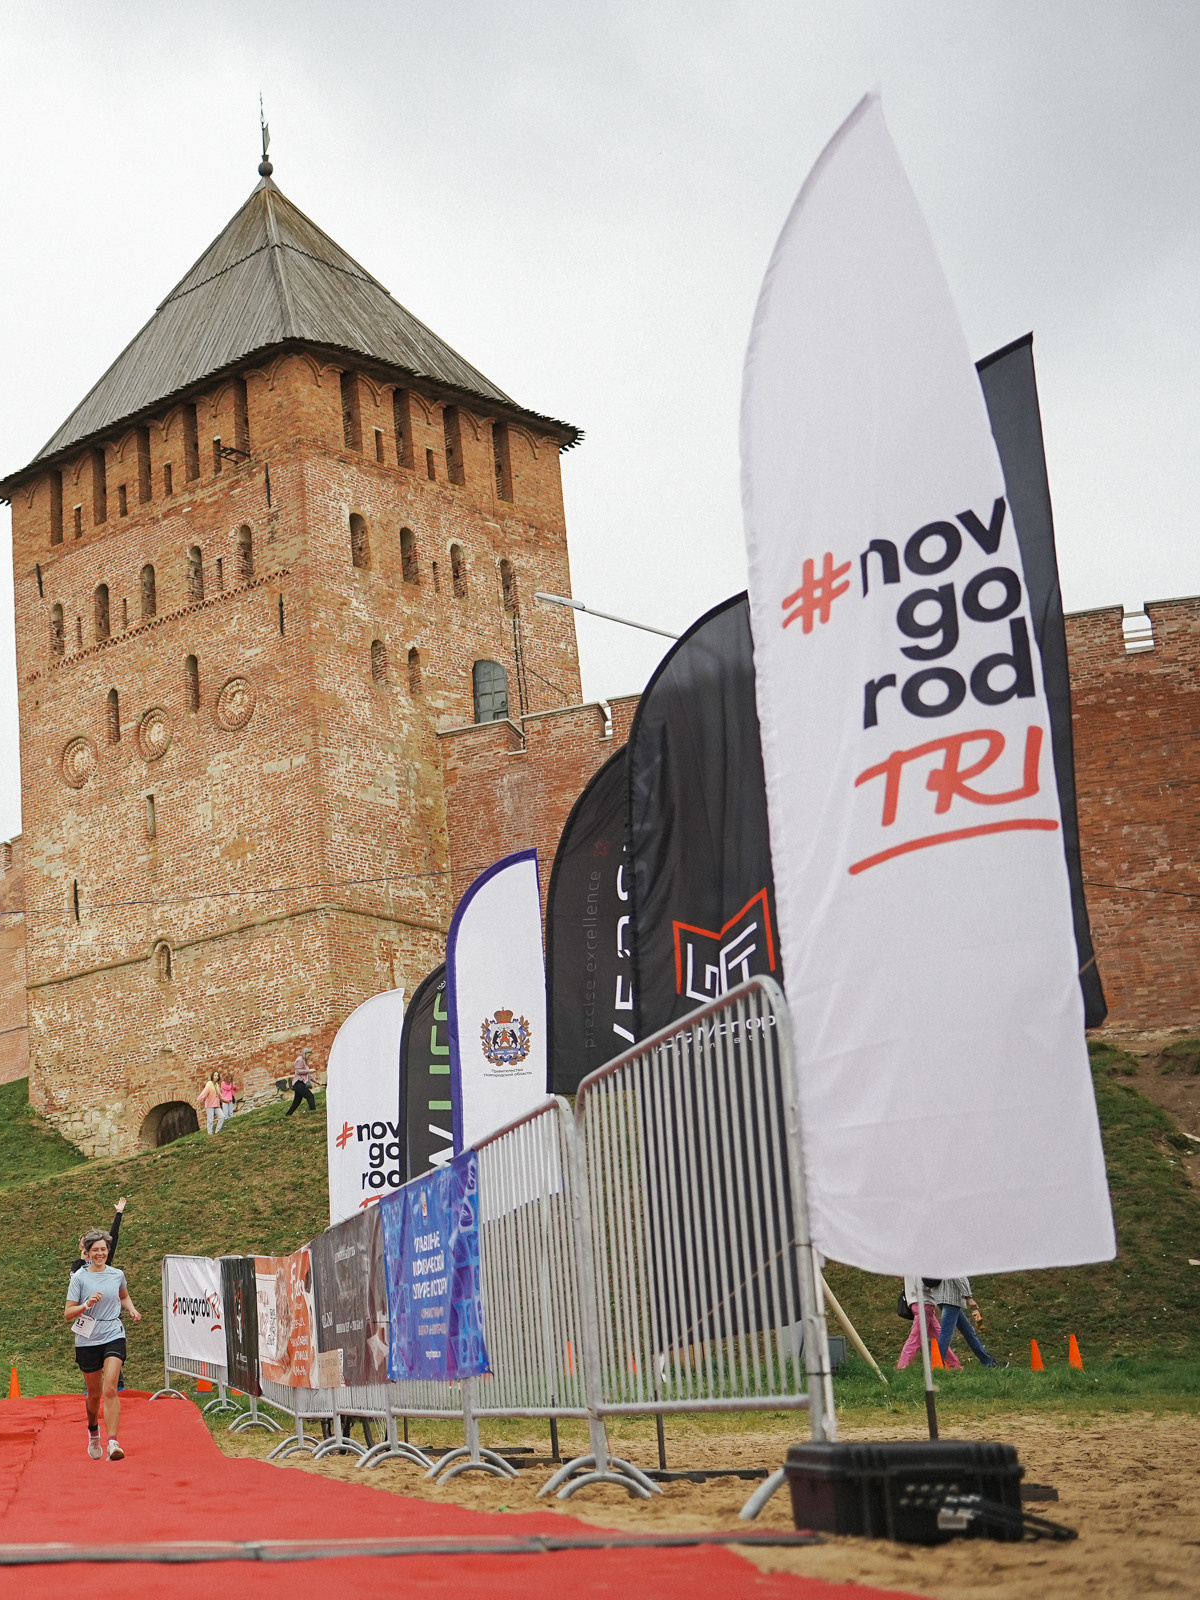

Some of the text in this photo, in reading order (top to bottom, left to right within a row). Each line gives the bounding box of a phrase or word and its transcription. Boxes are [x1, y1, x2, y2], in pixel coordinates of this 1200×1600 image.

[782, 495, 1006, 634] #nov
[896, 566, 1022, 661] go
[863, 616, 1036, 730] rod
[854, 725, 1043, 827] TRI
[336, 1121, 400, 1150] #nov
[369, 1142, 400, 1169] go
